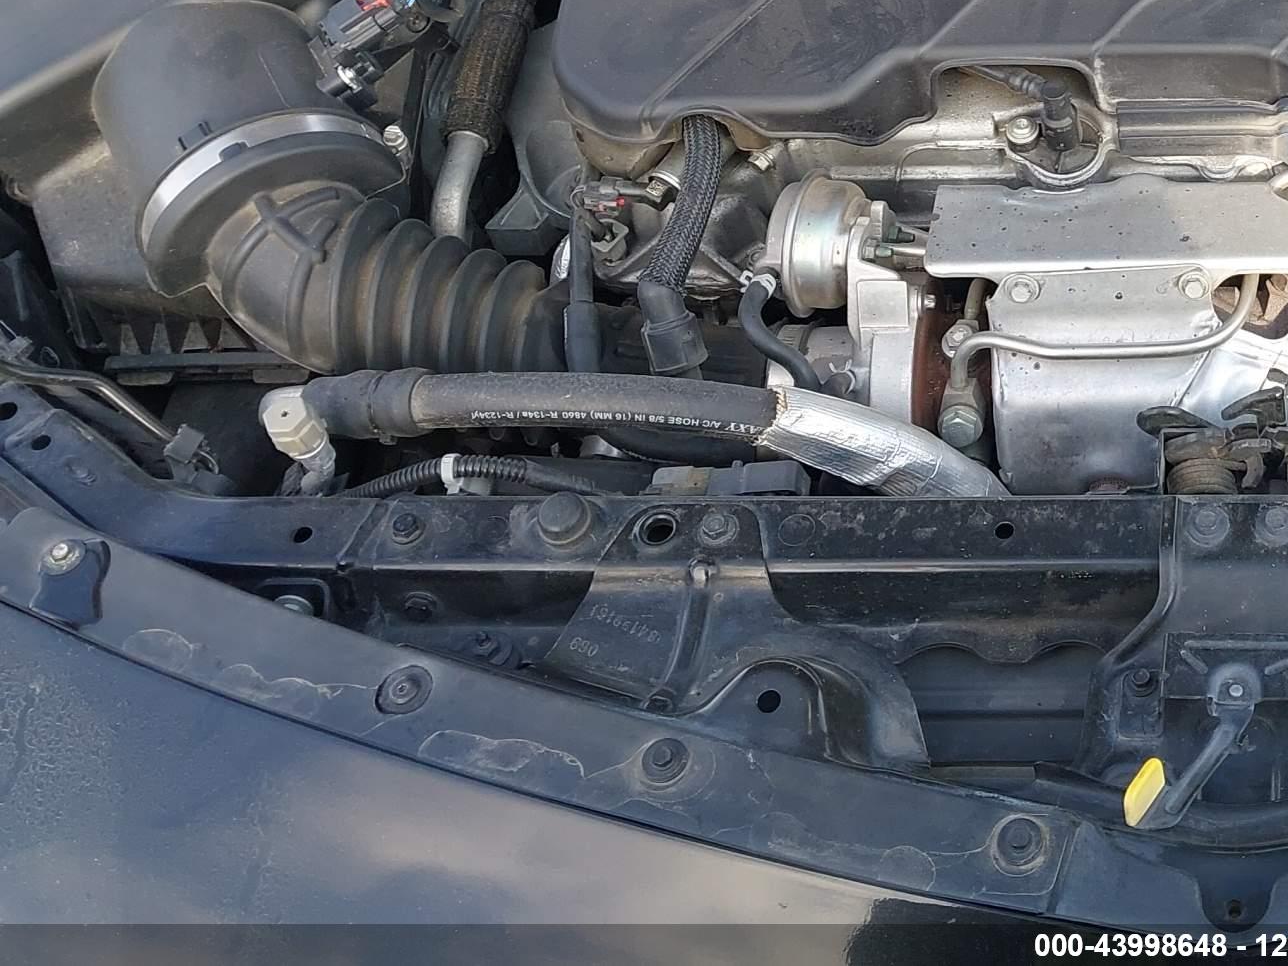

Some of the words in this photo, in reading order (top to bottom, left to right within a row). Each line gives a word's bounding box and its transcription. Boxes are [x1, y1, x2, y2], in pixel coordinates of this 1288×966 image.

[521, 410, 559, 419] R-134a
[562, 411, 587, 419] 4860
[589, 410, 613, 420] MM)
[615, 412, 632, 421] (16
[634, 413, 646, 422] IN
[648, 415, 665, 423] 5/8
[667, 417, 700, 426] HOSE
[701, 420, 722, 429] A/C
